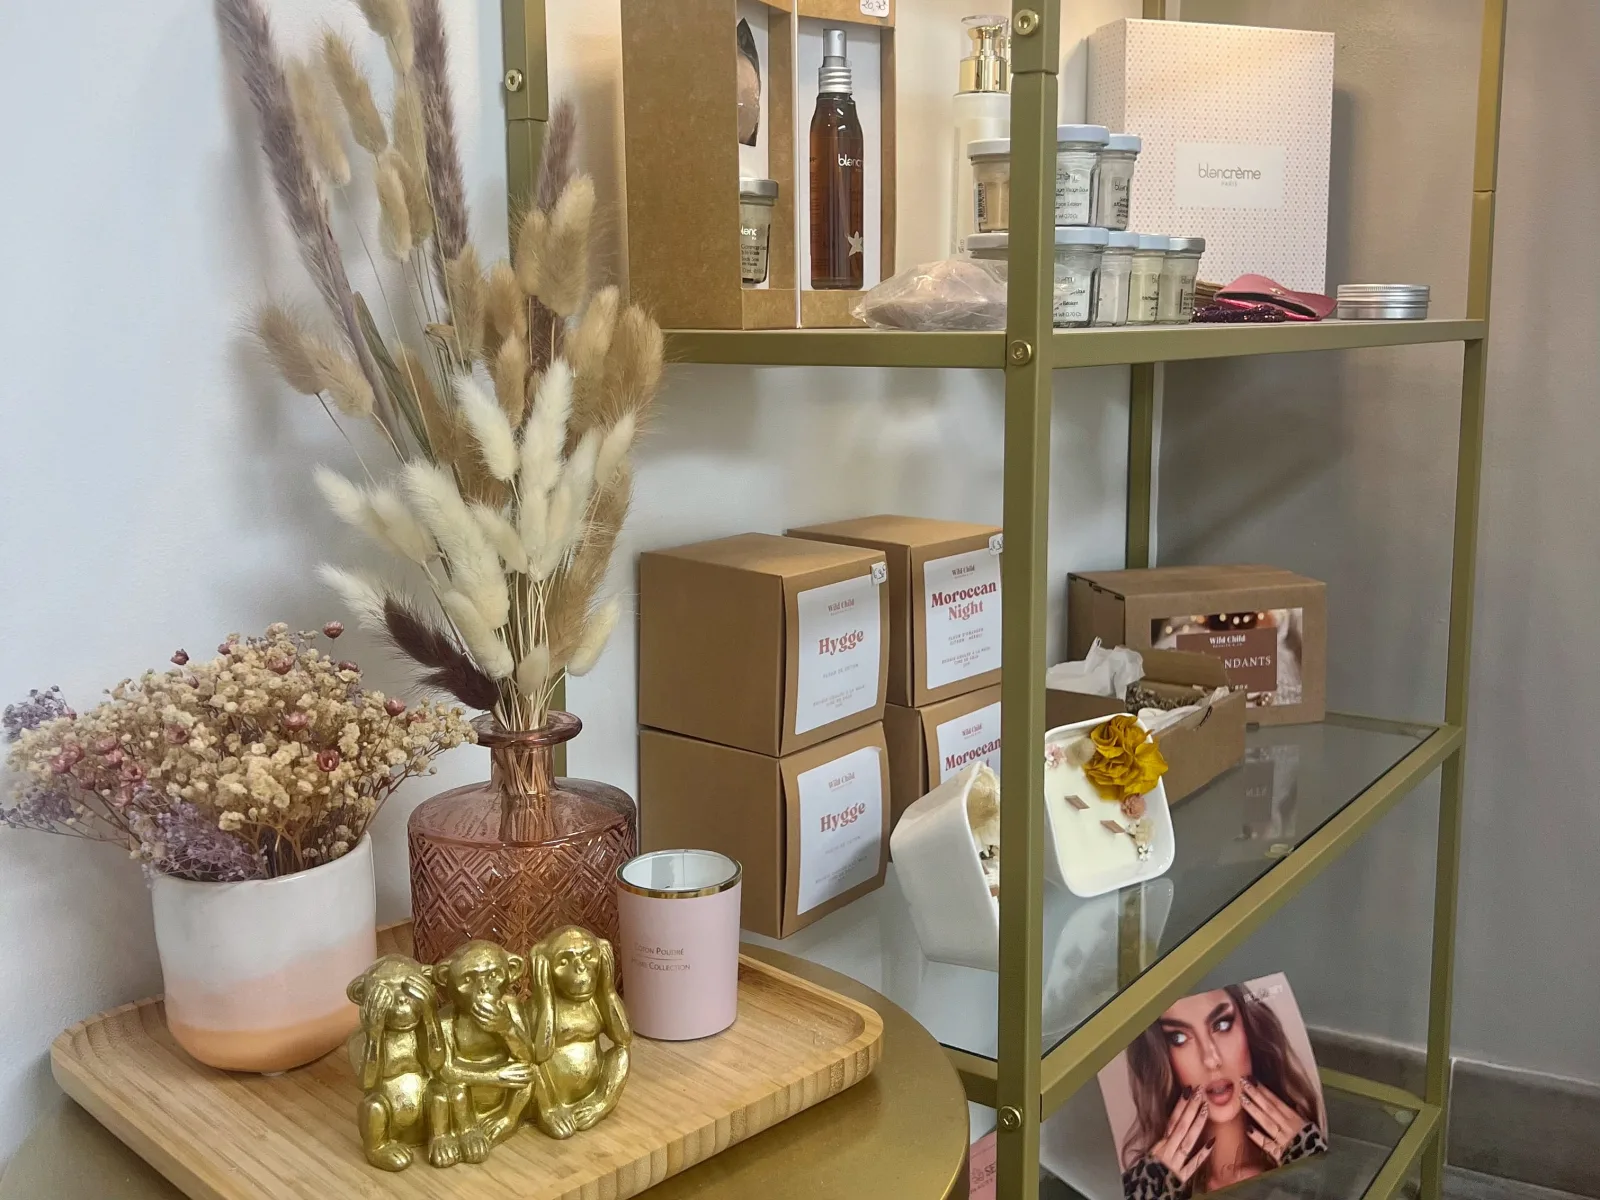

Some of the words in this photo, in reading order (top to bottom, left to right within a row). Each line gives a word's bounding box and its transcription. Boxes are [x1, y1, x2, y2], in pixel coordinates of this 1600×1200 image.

[1198, 163, 1261, 180] blancrème
[931, 582, 997, 608] Moroccan
[948, 600, 984, 621] Night
[818, 630, 865, 656] Hygge
[1209, 635, 1226, 645] Wild
[1226, 634, 1246, 644] Child
[1224, 655, 1271, 669] NDANTS
[945, 738, 1000, 771] Moroccan
[820, 802, 866, 832] Hygge
